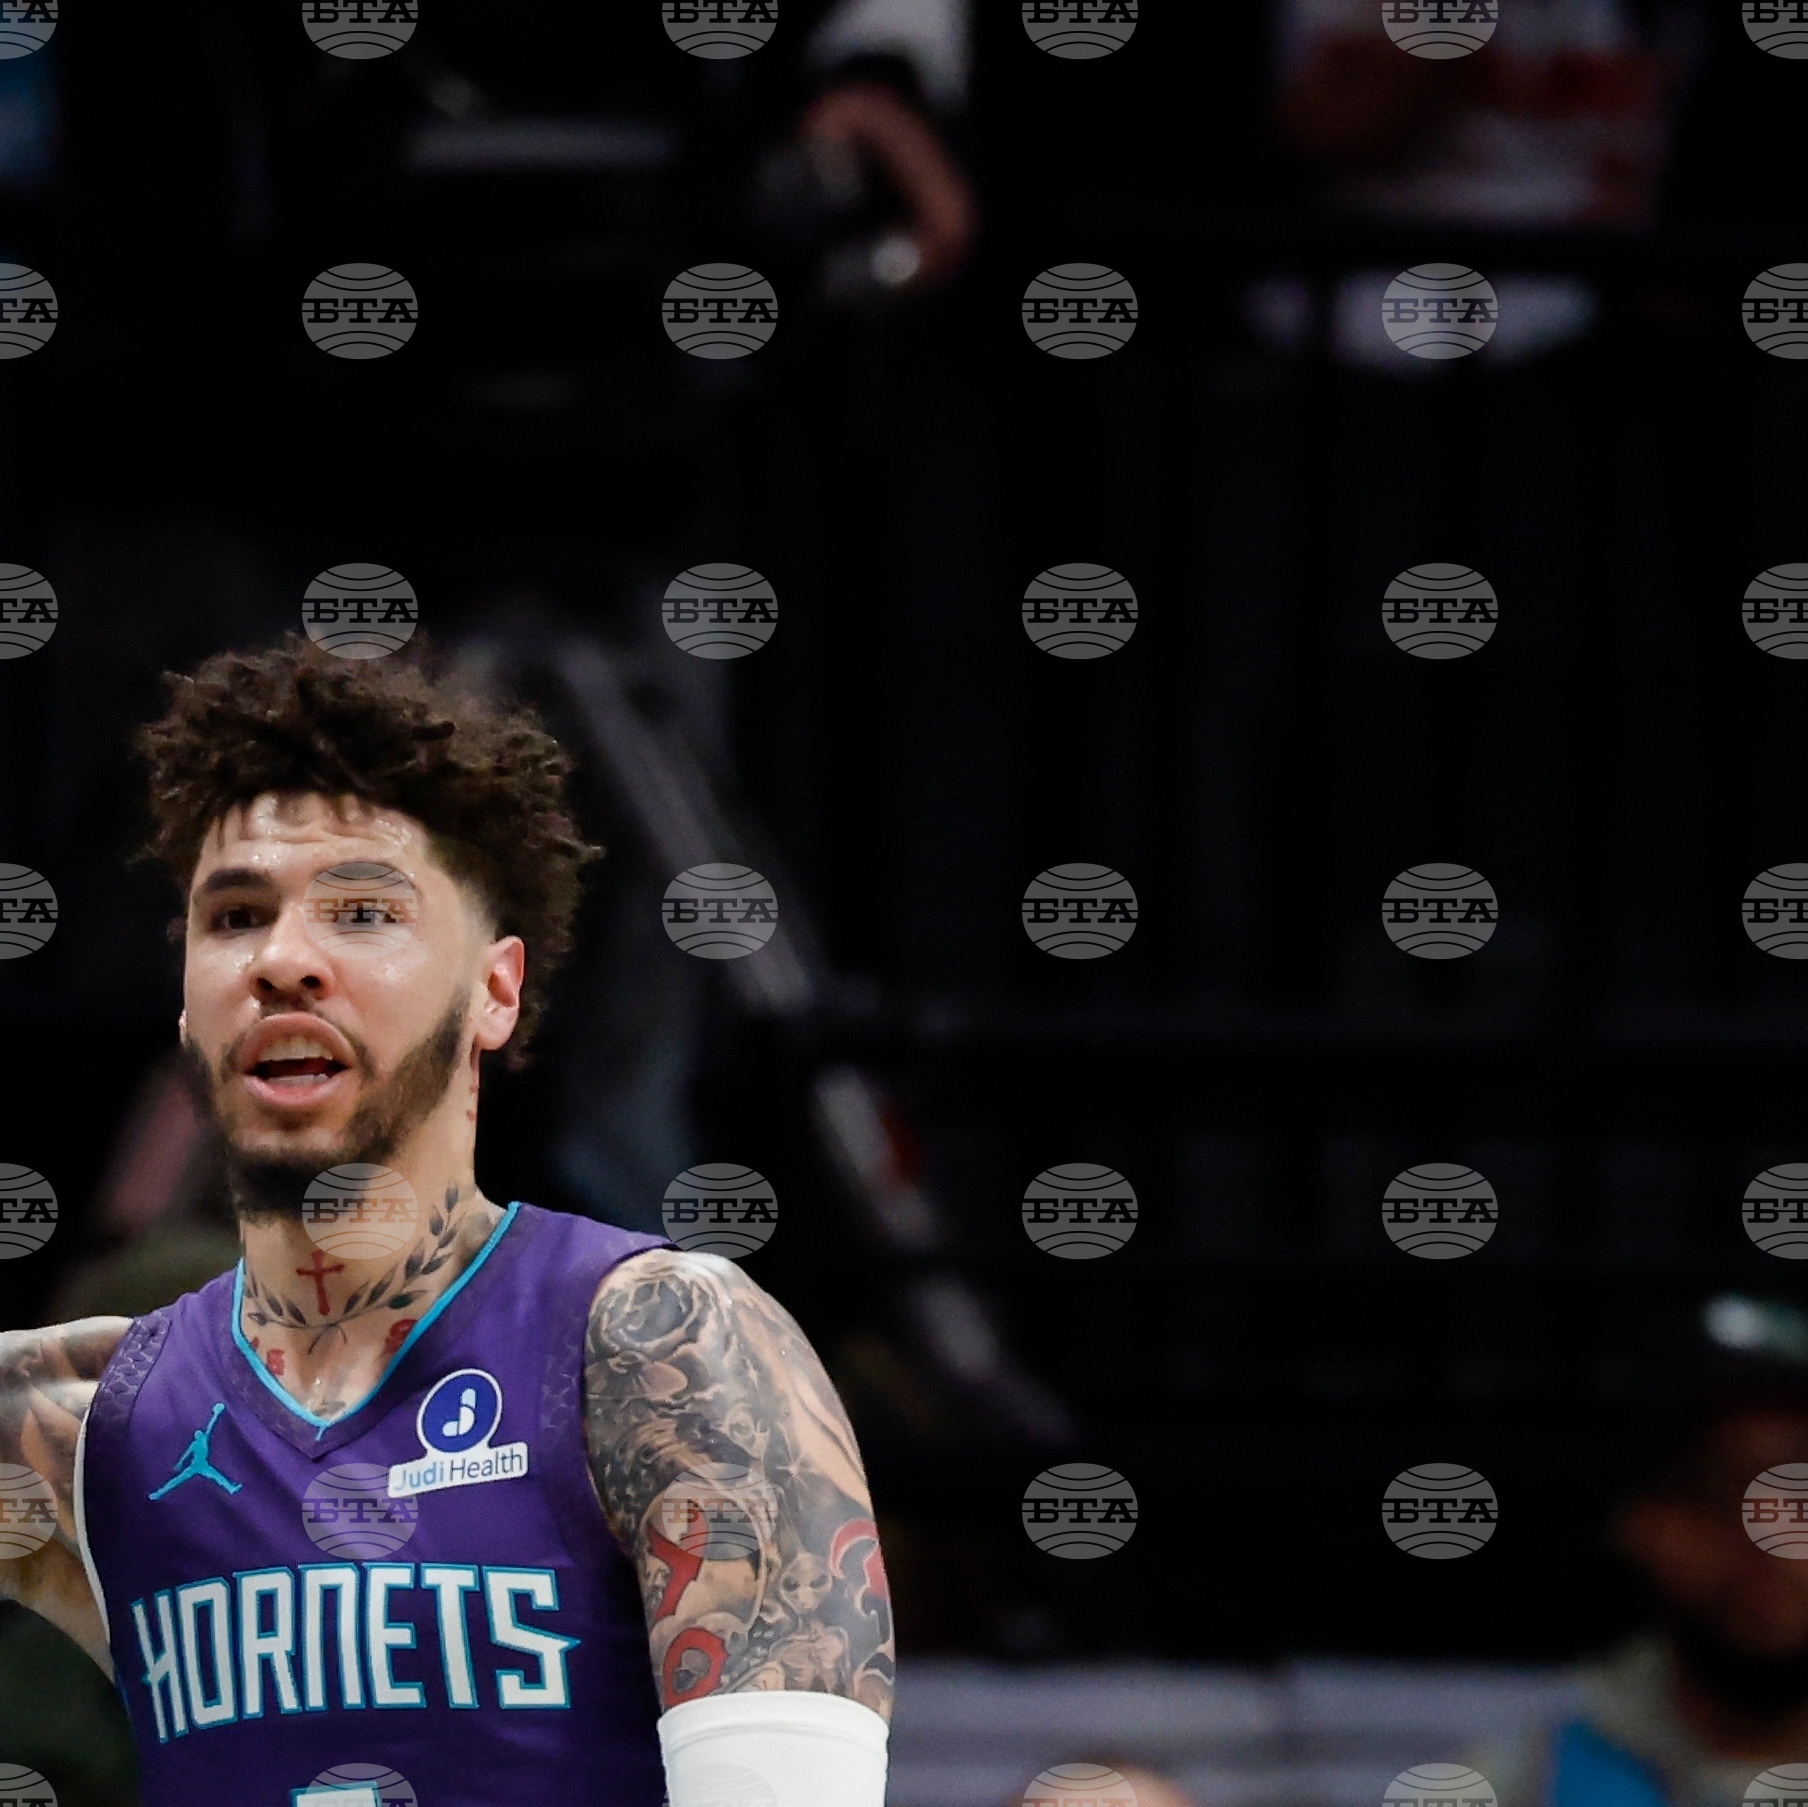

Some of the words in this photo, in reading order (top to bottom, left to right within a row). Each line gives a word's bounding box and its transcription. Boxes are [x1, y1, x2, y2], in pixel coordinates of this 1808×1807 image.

[392, 1463, 445, 1492] Judi
[449, 1450, 525, 1483] Health
[130, 1562, 581, 1743] HORNETS
